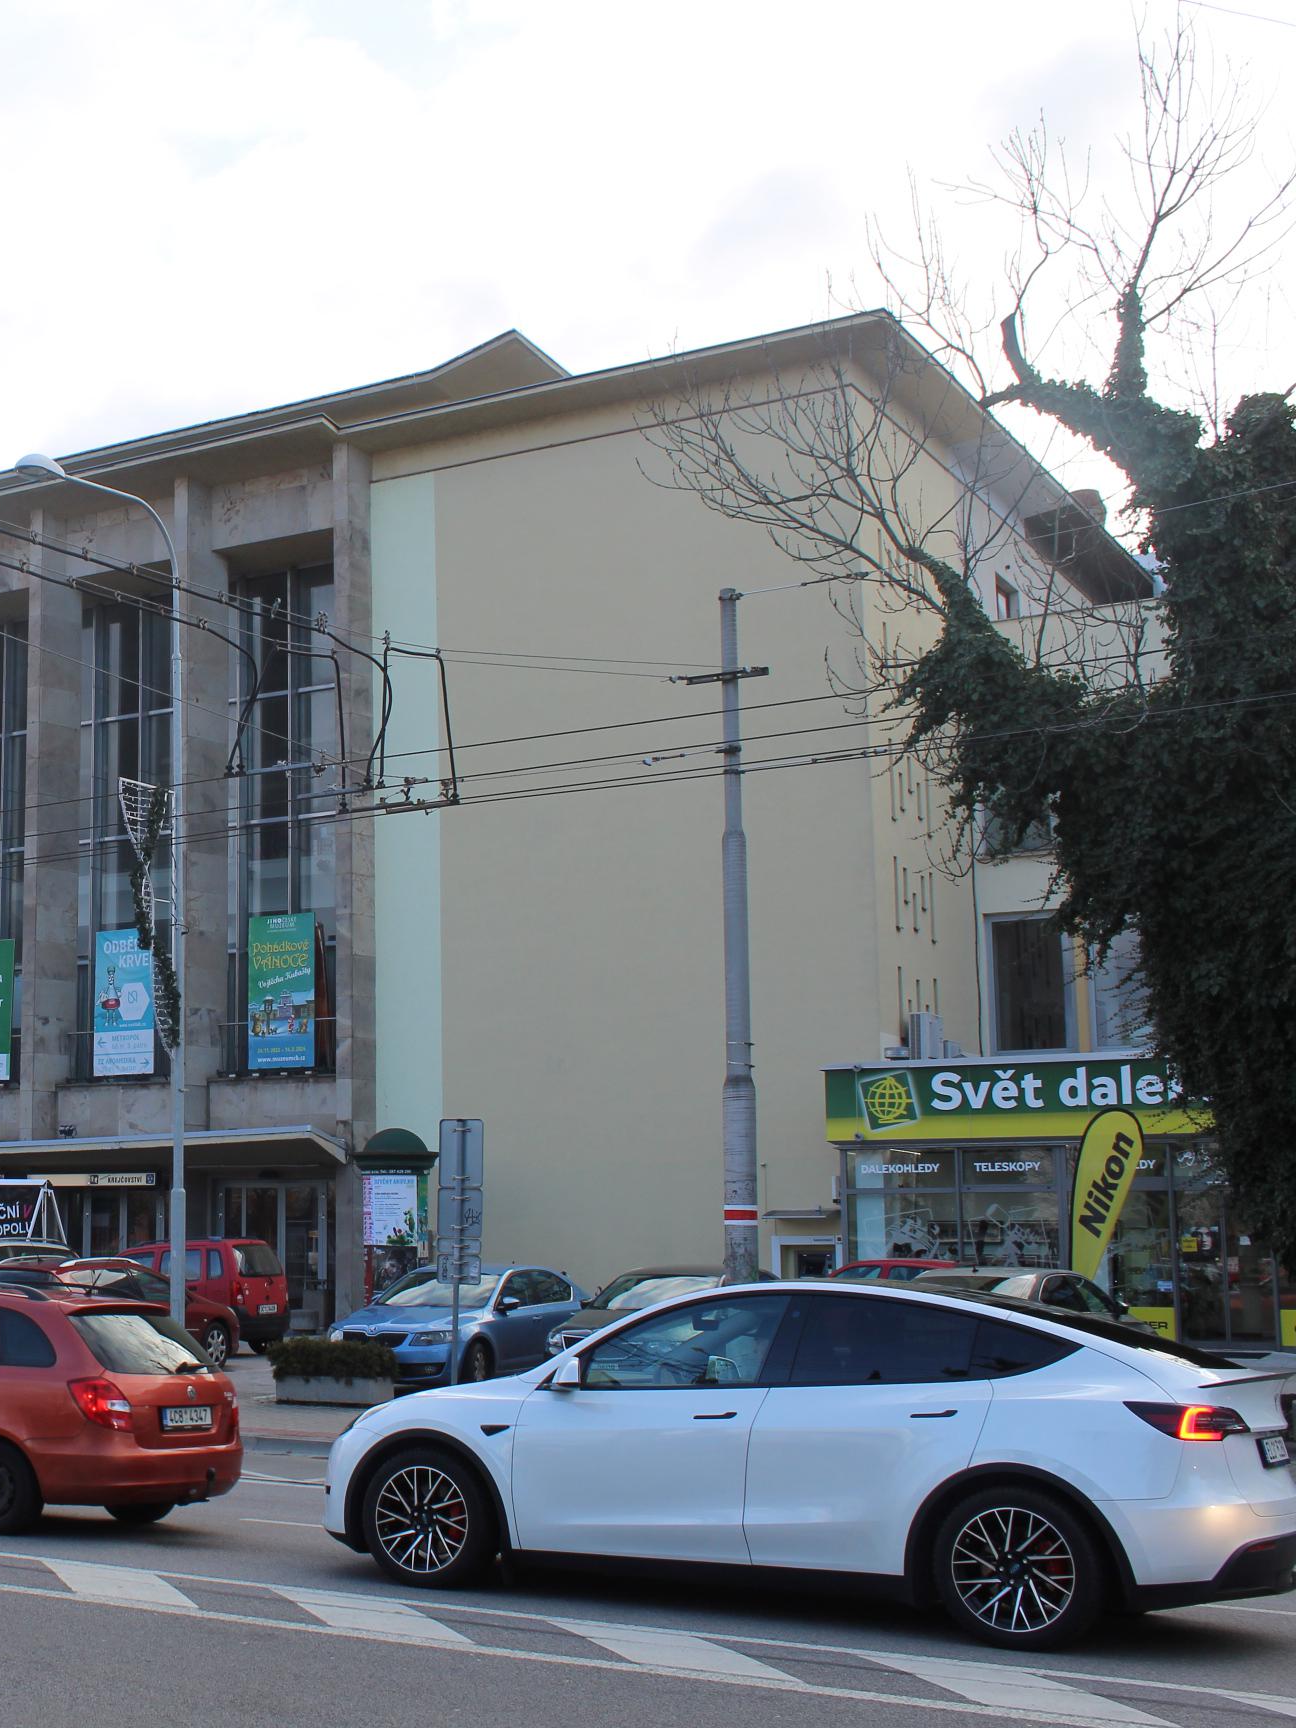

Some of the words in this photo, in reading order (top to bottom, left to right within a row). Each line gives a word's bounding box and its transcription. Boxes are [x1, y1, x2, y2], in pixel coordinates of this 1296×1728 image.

[119, 953, 149, 968] KRVE
[930, 1068, 1044, 1112] Svět
[860, 1163, 940, 1175] DALEKOHLEDY
[973, 1161, 1040, 1173] TELESKOPY
[1079, 1131, 1135, 1239] Nikon
